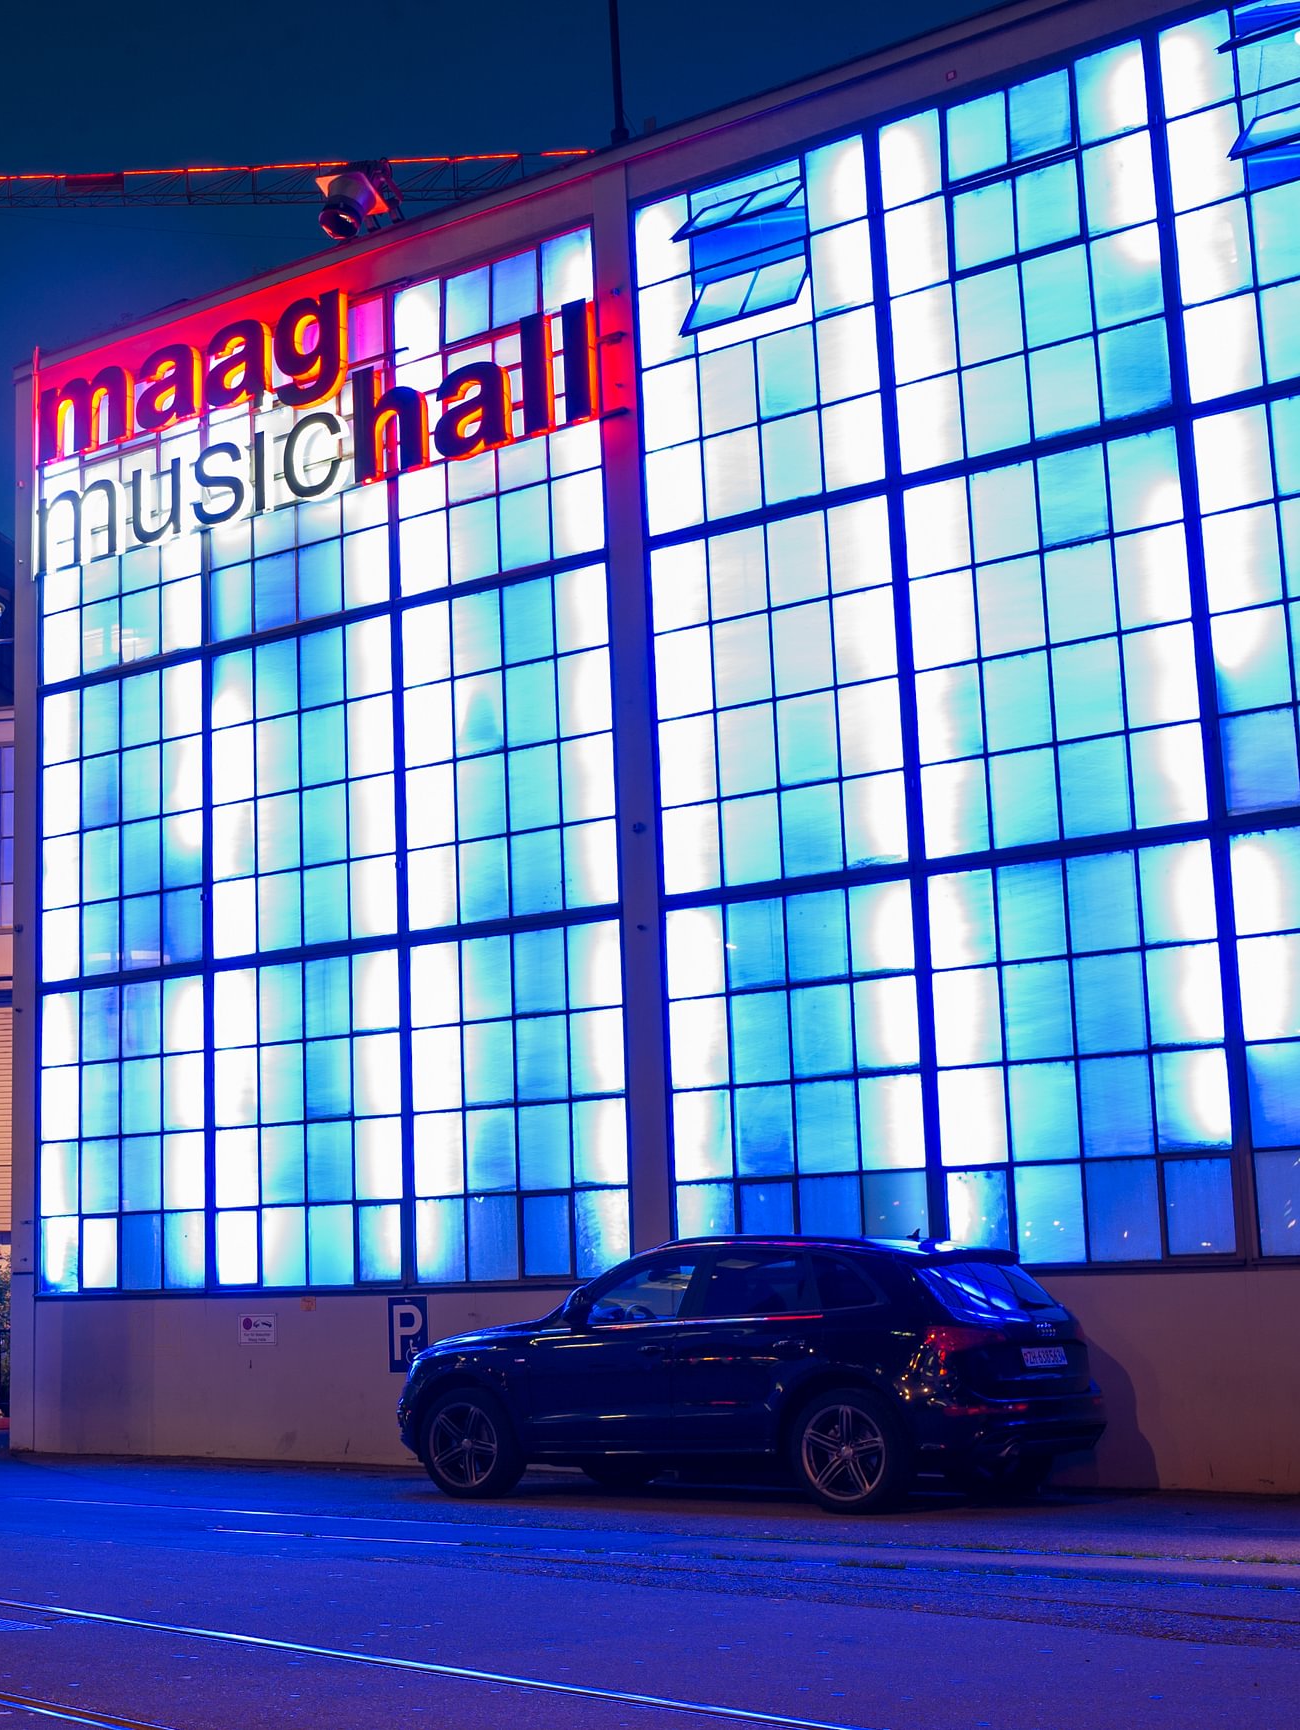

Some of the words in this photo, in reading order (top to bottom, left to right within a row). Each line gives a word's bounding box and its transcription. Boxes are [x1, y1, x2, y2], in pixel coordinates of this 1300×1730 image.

[38, 411, 346, 573] music
[352, 298, 598, 484] hall
[40, 288, 348, 464] maag
[393, 1304, 422, 1360] P
